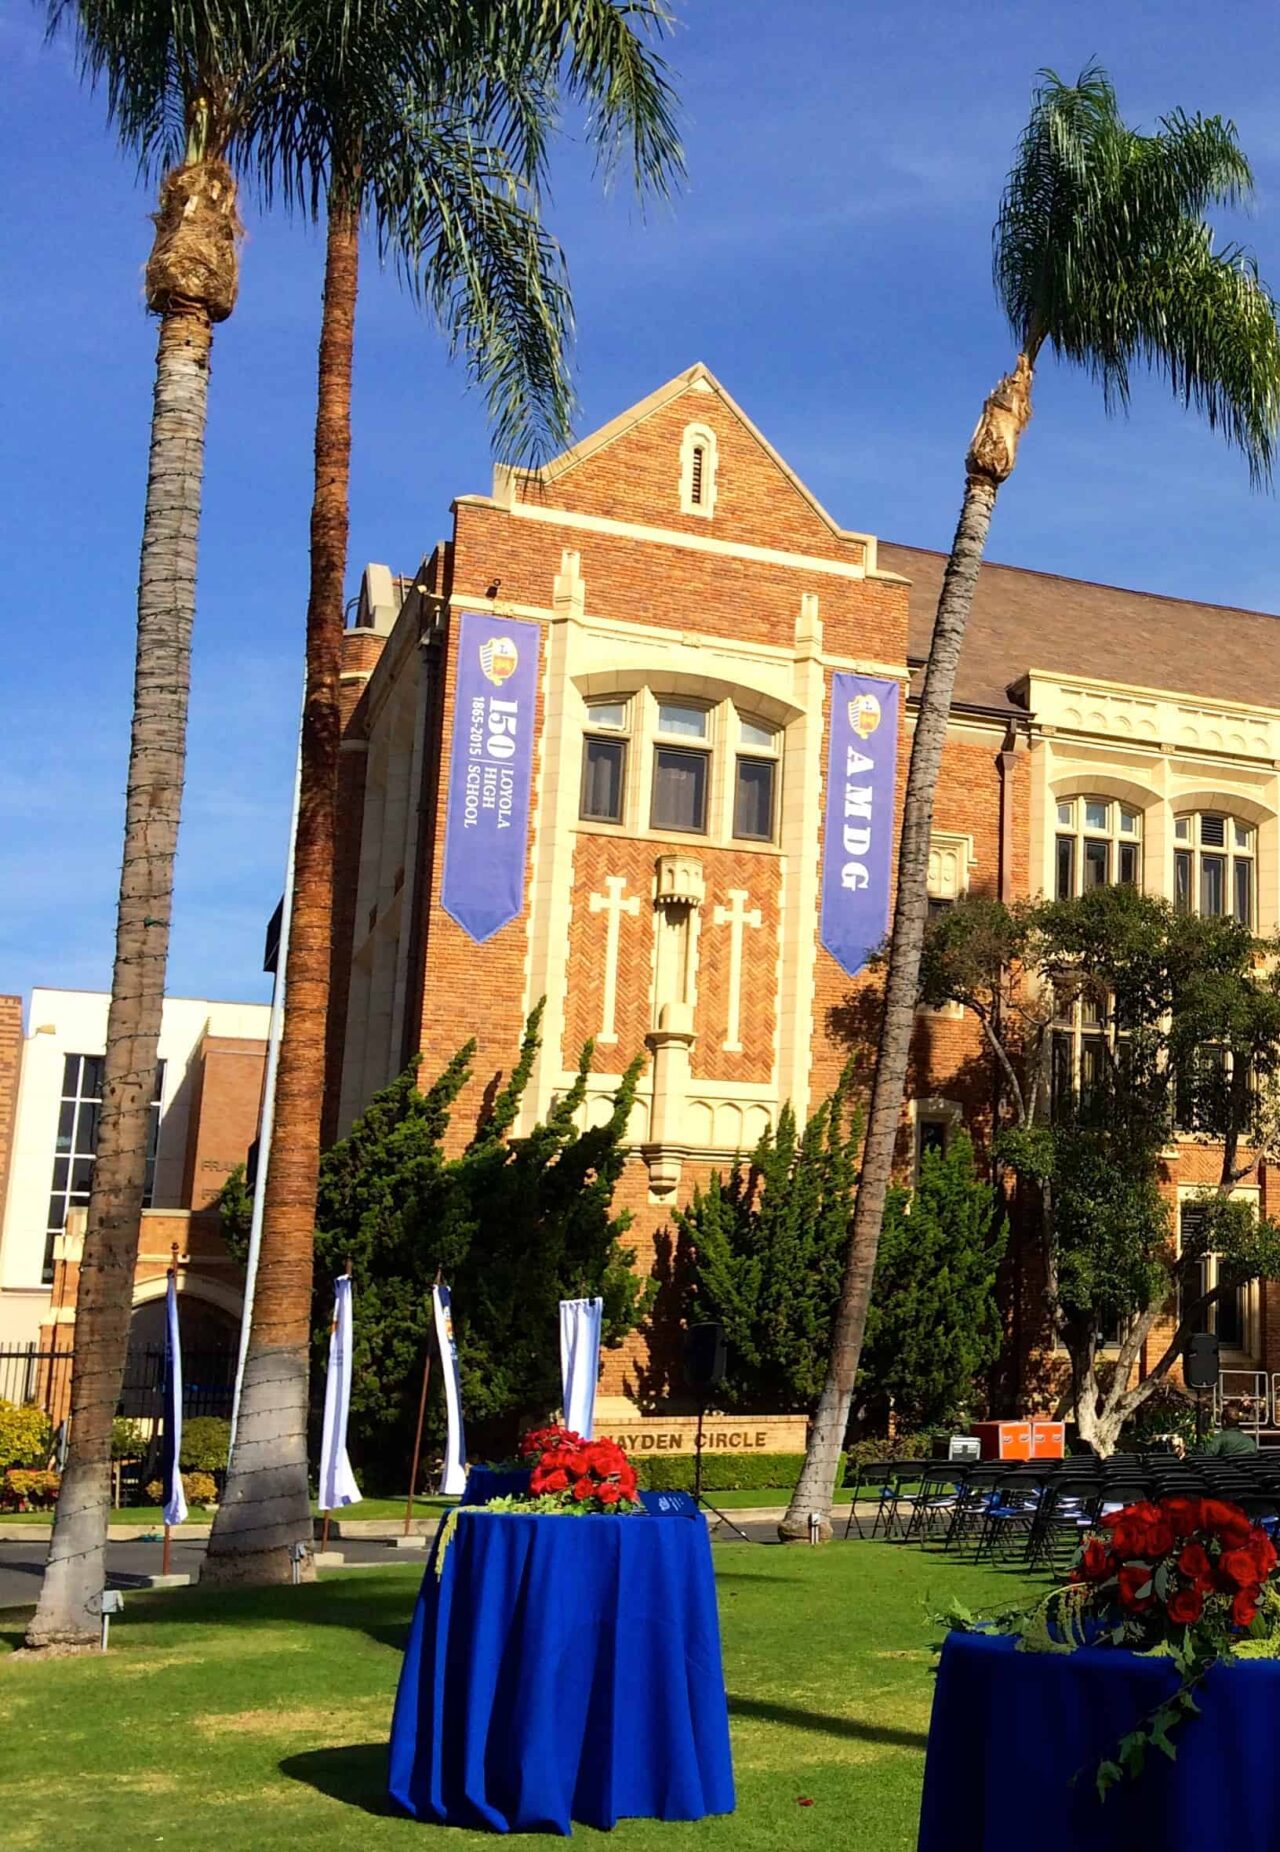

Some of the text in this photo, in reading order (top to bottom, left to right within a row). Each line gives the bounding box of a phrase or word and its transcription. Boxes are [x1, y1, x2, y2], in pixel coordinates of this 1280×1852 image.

[469, 696, 485, 755] 1865-2015
[487, 696, 518, 759] 150
[464, 764, 481, 828] SCHOOL
[482, 767, 498, 809] HIGH
[497, 769, 514, 829] LOYOLA
[841, 746, 874, 892] AMDG
[694, 1431, 767, 1448] CIRCLE
